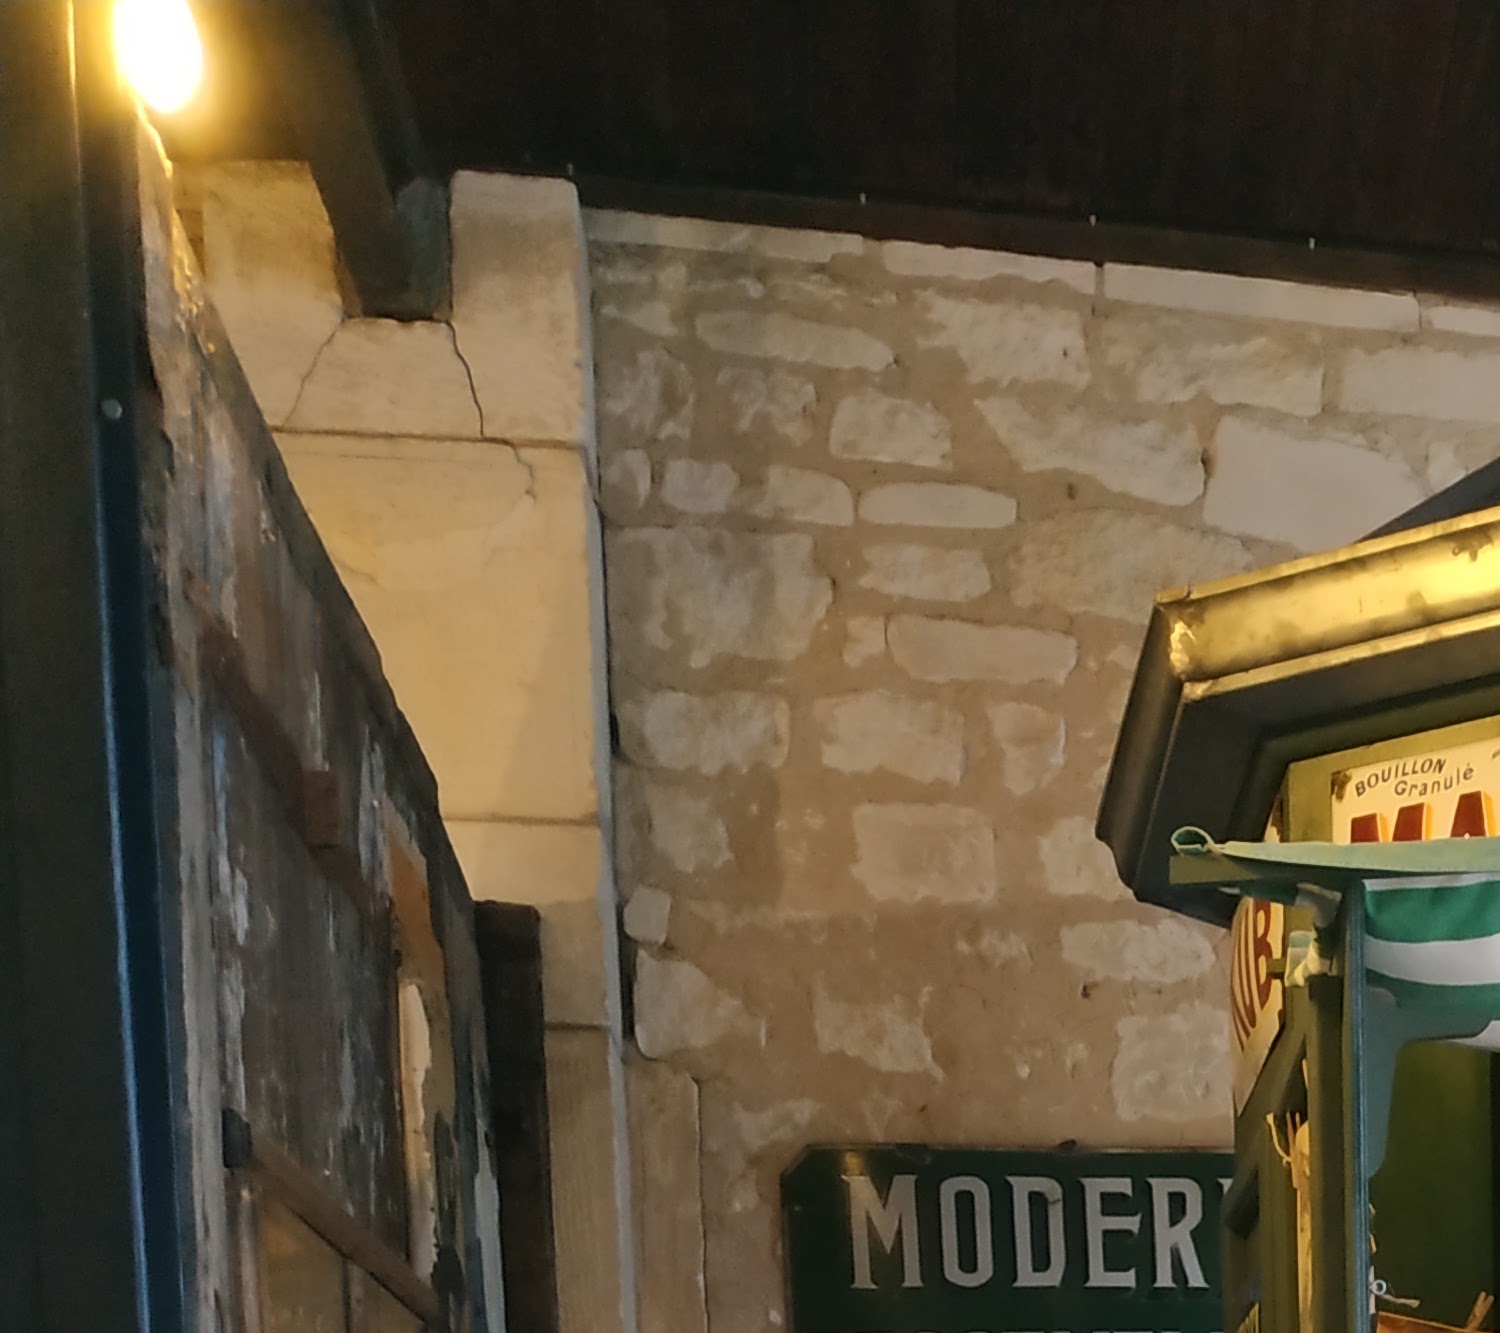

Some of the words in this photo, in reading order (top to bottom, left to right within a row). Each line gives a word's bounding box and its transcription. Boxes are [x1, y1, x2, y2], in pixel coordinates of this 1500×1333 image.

[1355, 758, 1447, 797] BOUILLON
[1393, 763, 1474, 797] Granulé
[842, 1174, 1233, 1291] MODER
